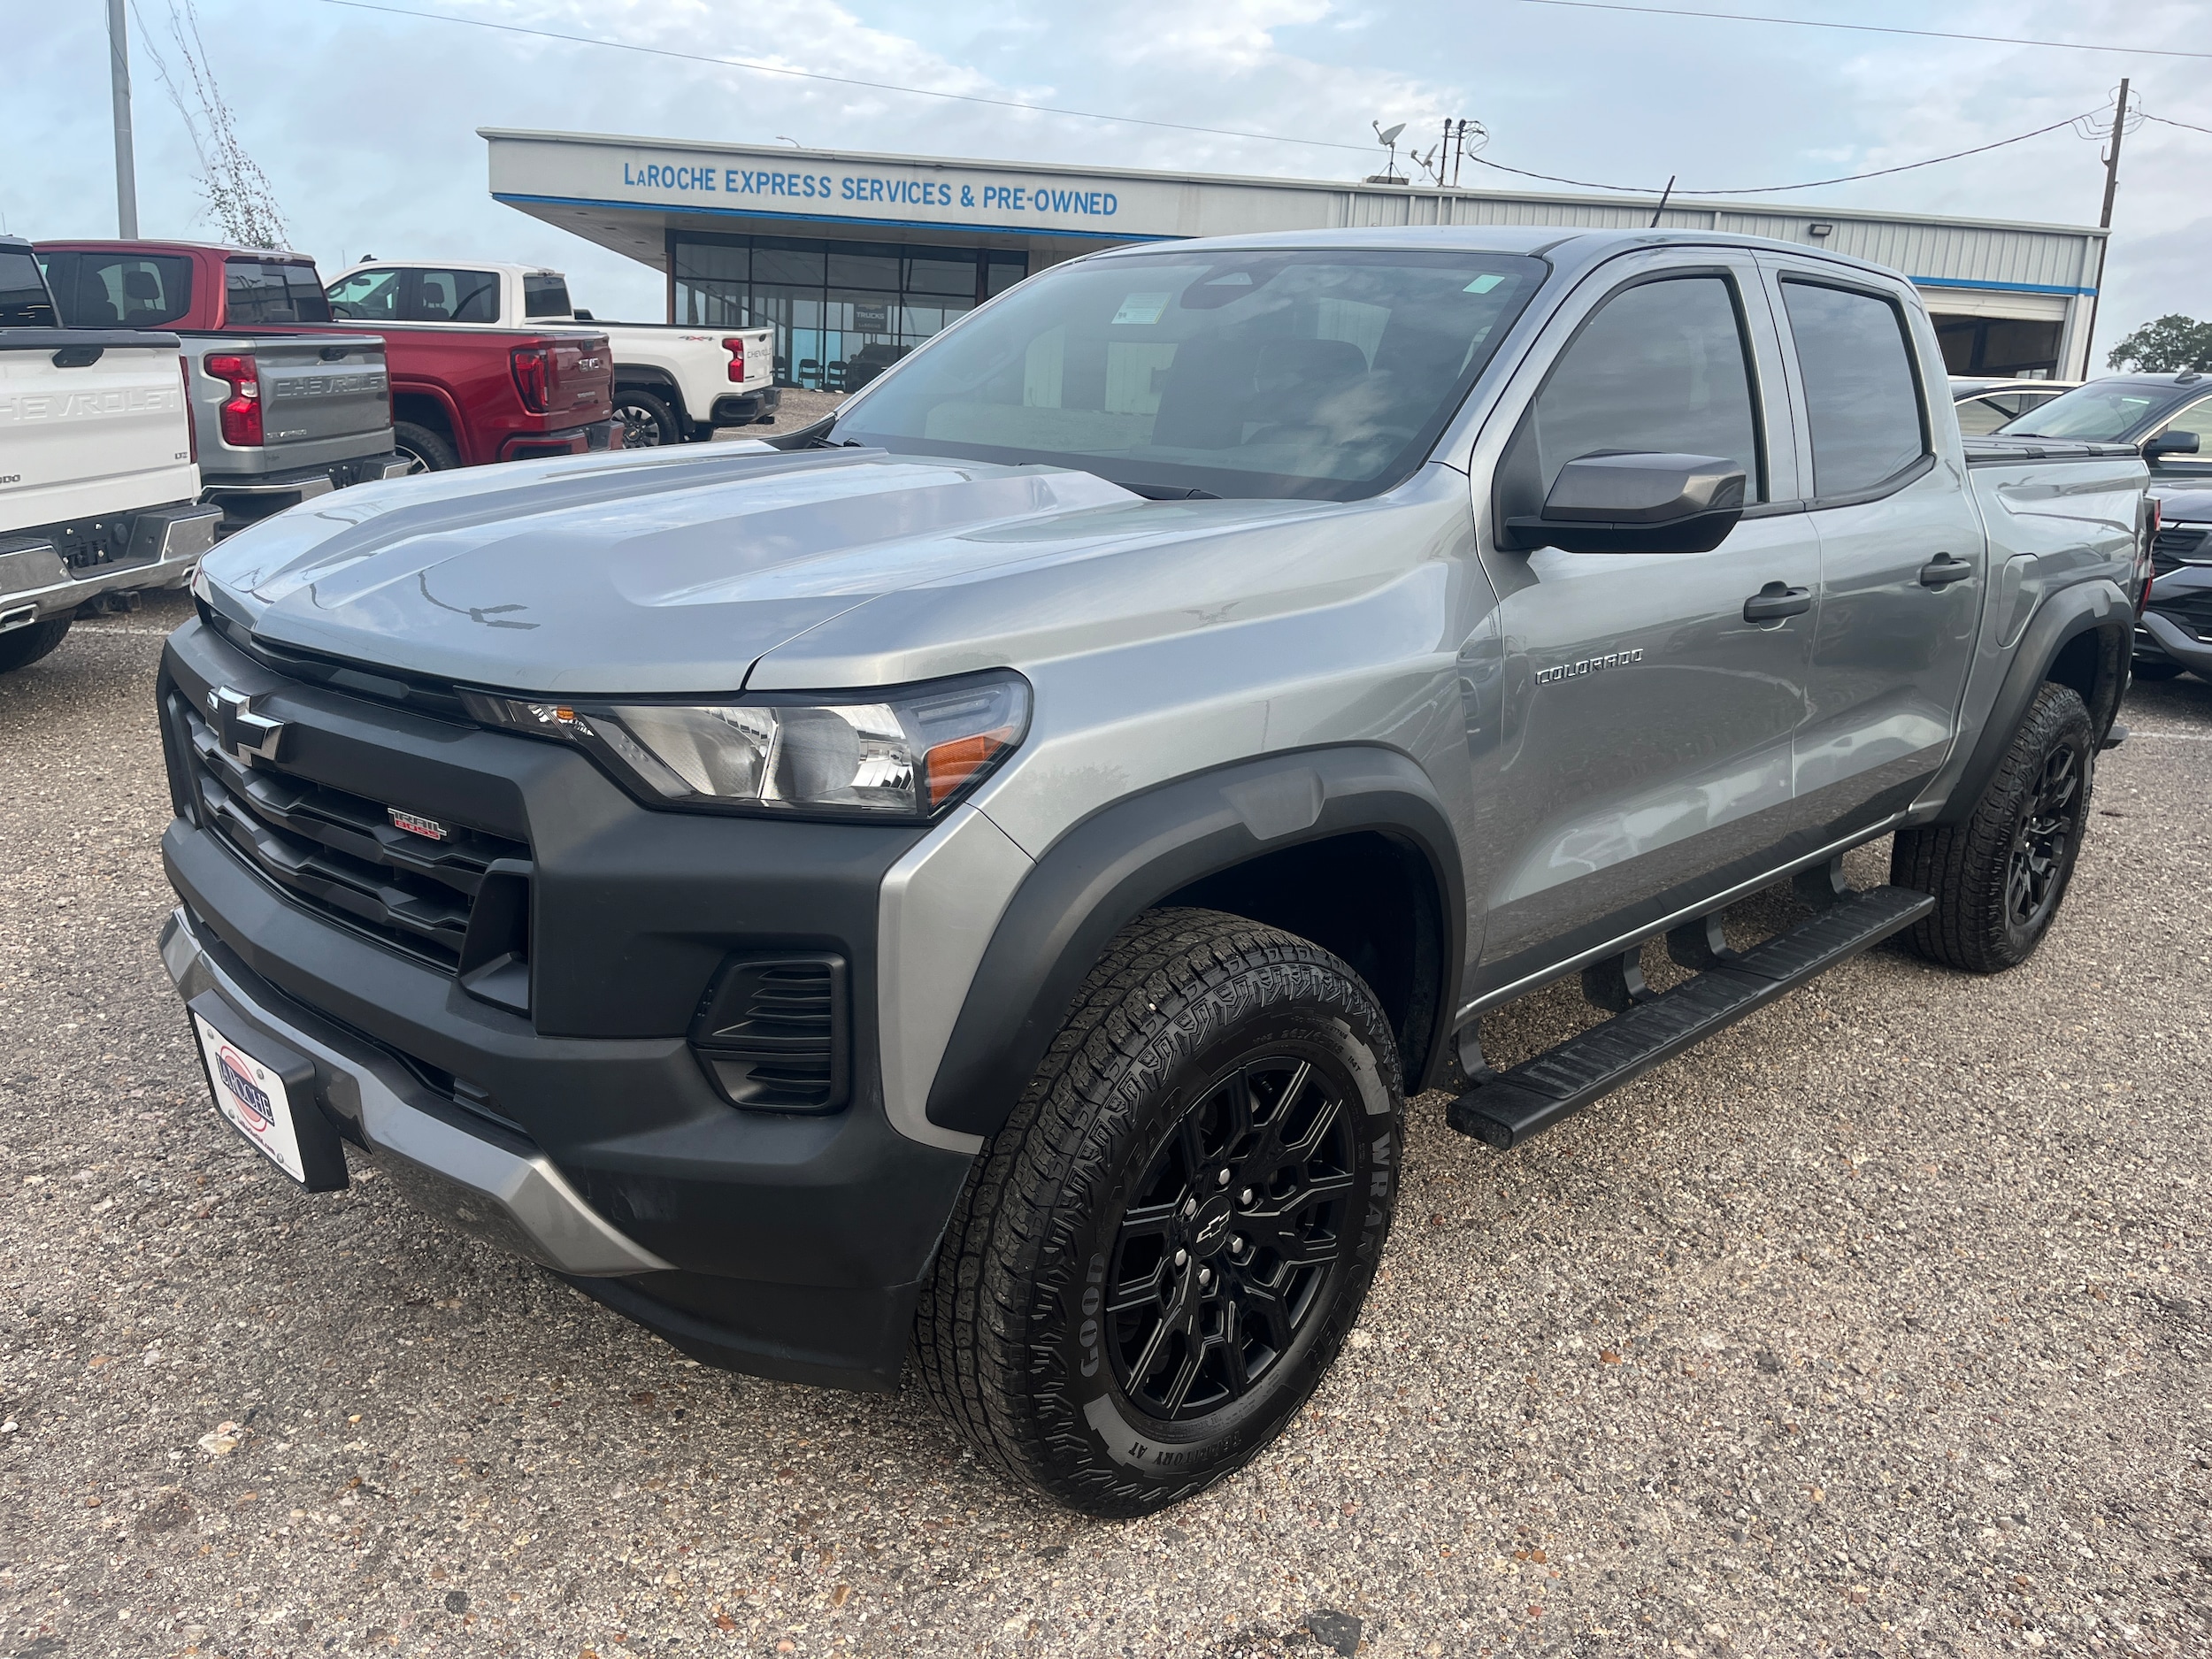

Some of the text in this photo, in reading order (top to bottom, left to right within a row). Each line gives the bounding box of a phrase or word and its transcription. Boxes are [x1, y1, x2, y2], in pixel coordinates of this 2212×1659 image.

[725, 170, 832, 198] EXPRESS
[841, 177, 952, 206] SERVICES
[960, 185, 975, 208] &
[984, 186, 1118, 216] PRE-OWNED
[275, 375, 388, 397] CHEVROLET
[0, 387, 178, 420] HEVROLET
[1535, 648, 1644, 685] COLORADO
[388, 807, 447, 836] TRAIL
[395, 819, 441, 840] BOSS
[1303, 1131, 1390, 1372] WRANGLER
[1128, 1440, 1148, 1460] AT
